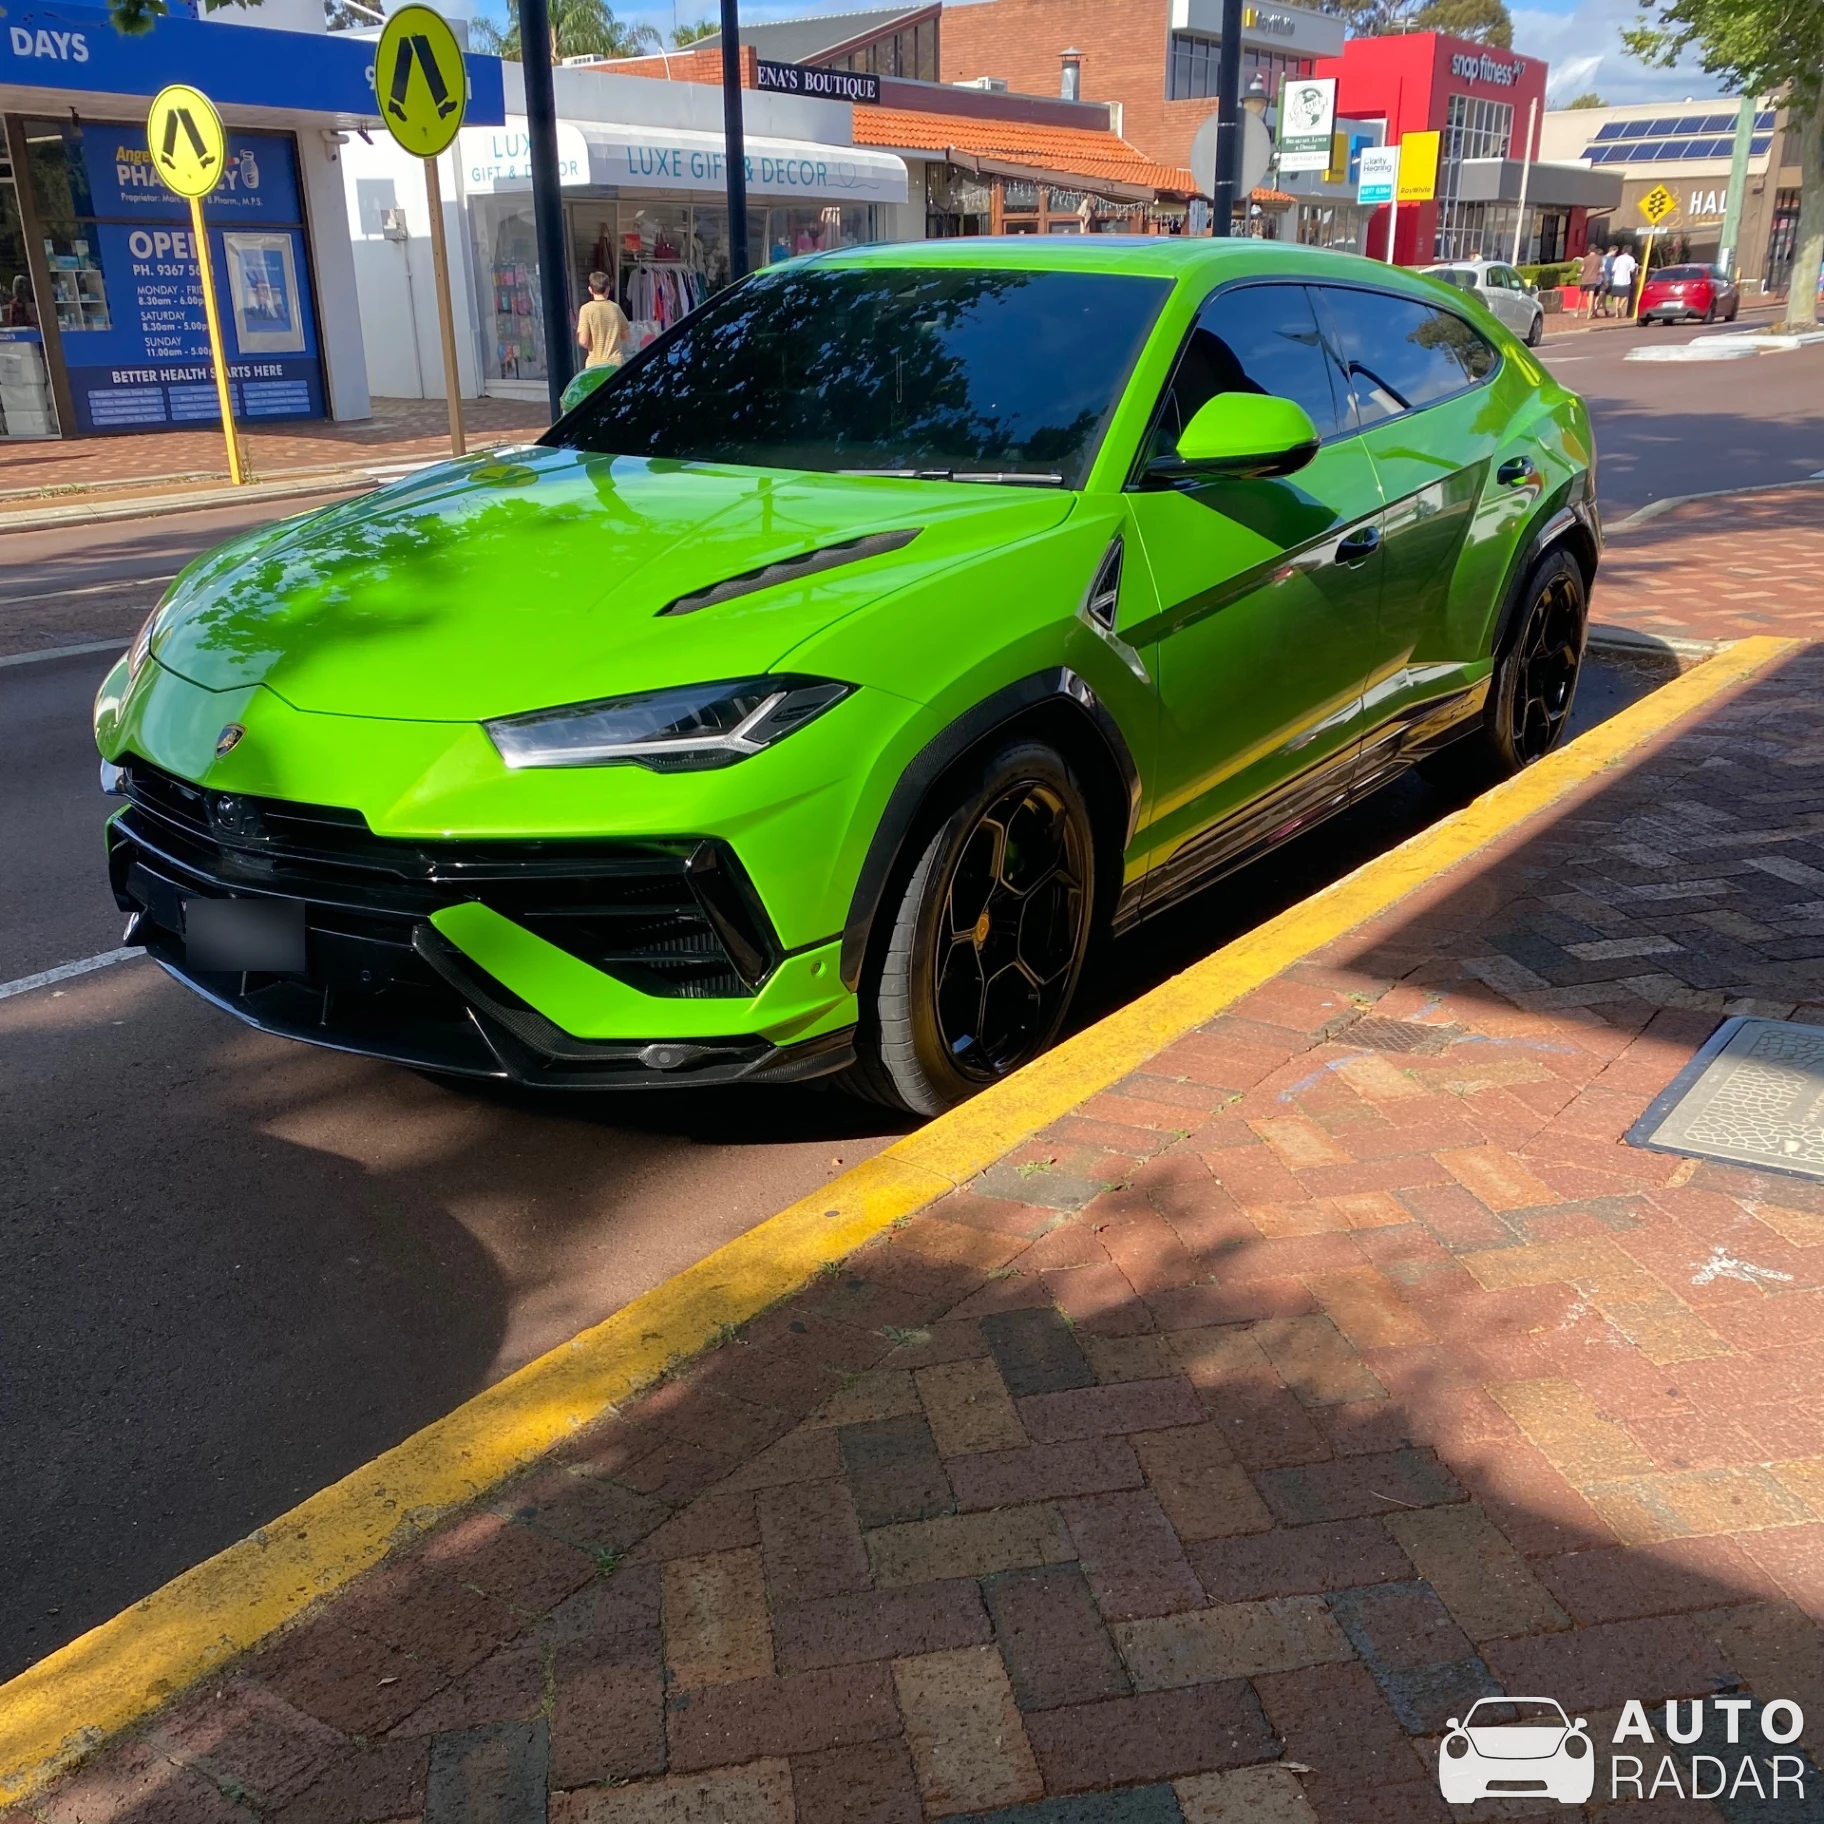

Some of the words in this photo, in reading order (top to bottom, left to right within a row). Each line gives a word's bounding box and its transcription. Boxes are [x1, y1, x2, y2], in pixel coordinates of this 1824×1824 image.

[9, 26, 89, 62] DAYS
[1452, 53, 1478, 86] snap
[1480, 52, 1512, 86] fitness
[804, 71, 876, 100] BOUTIQUE
[493, 133, 532, 158] LUX
[116, 146, 151, 166] Ange
[1364, 156, 1388, 165] Clarity
[472, 166, 502, 182] GIFT
[509, 165, 517, 179] &
[525, 160, 579, 179] DOR
[627, 147, 682, 177] LUXE
[690, 152, 727, 180] GIF
[762, 157, 828, 187] DECOR
[1363, 164, 1392, 173] Hearing
[1400, 186, 1431, 194] RayWhite
[1689, 190, 1728, 215] HAL
[133, 265, 154, 276] PH.
[157, 265, 184, 276] 9367
[137, 285, 178, 295] MONDAY
[138, 297, 171, 305] 8.30am
[180, 296, 205, 307] 6.00p
[140, 311, 186, 321] SATURDAY
[142, 322, 175, 331] 8.30am
[184, 322, 209, 333] 5.00p
[144, 337, 182, 347] SUNDAY
[146, 348, 182, 357] 11.00am
[190, 347, 213, 358] 5.00p
[112, 369, 158, 384] BETTER
[160, 367, 206, 382] HEALTH
[210, 366, 251, 380] SARTS
[254, 364, 283, 377] HERE
